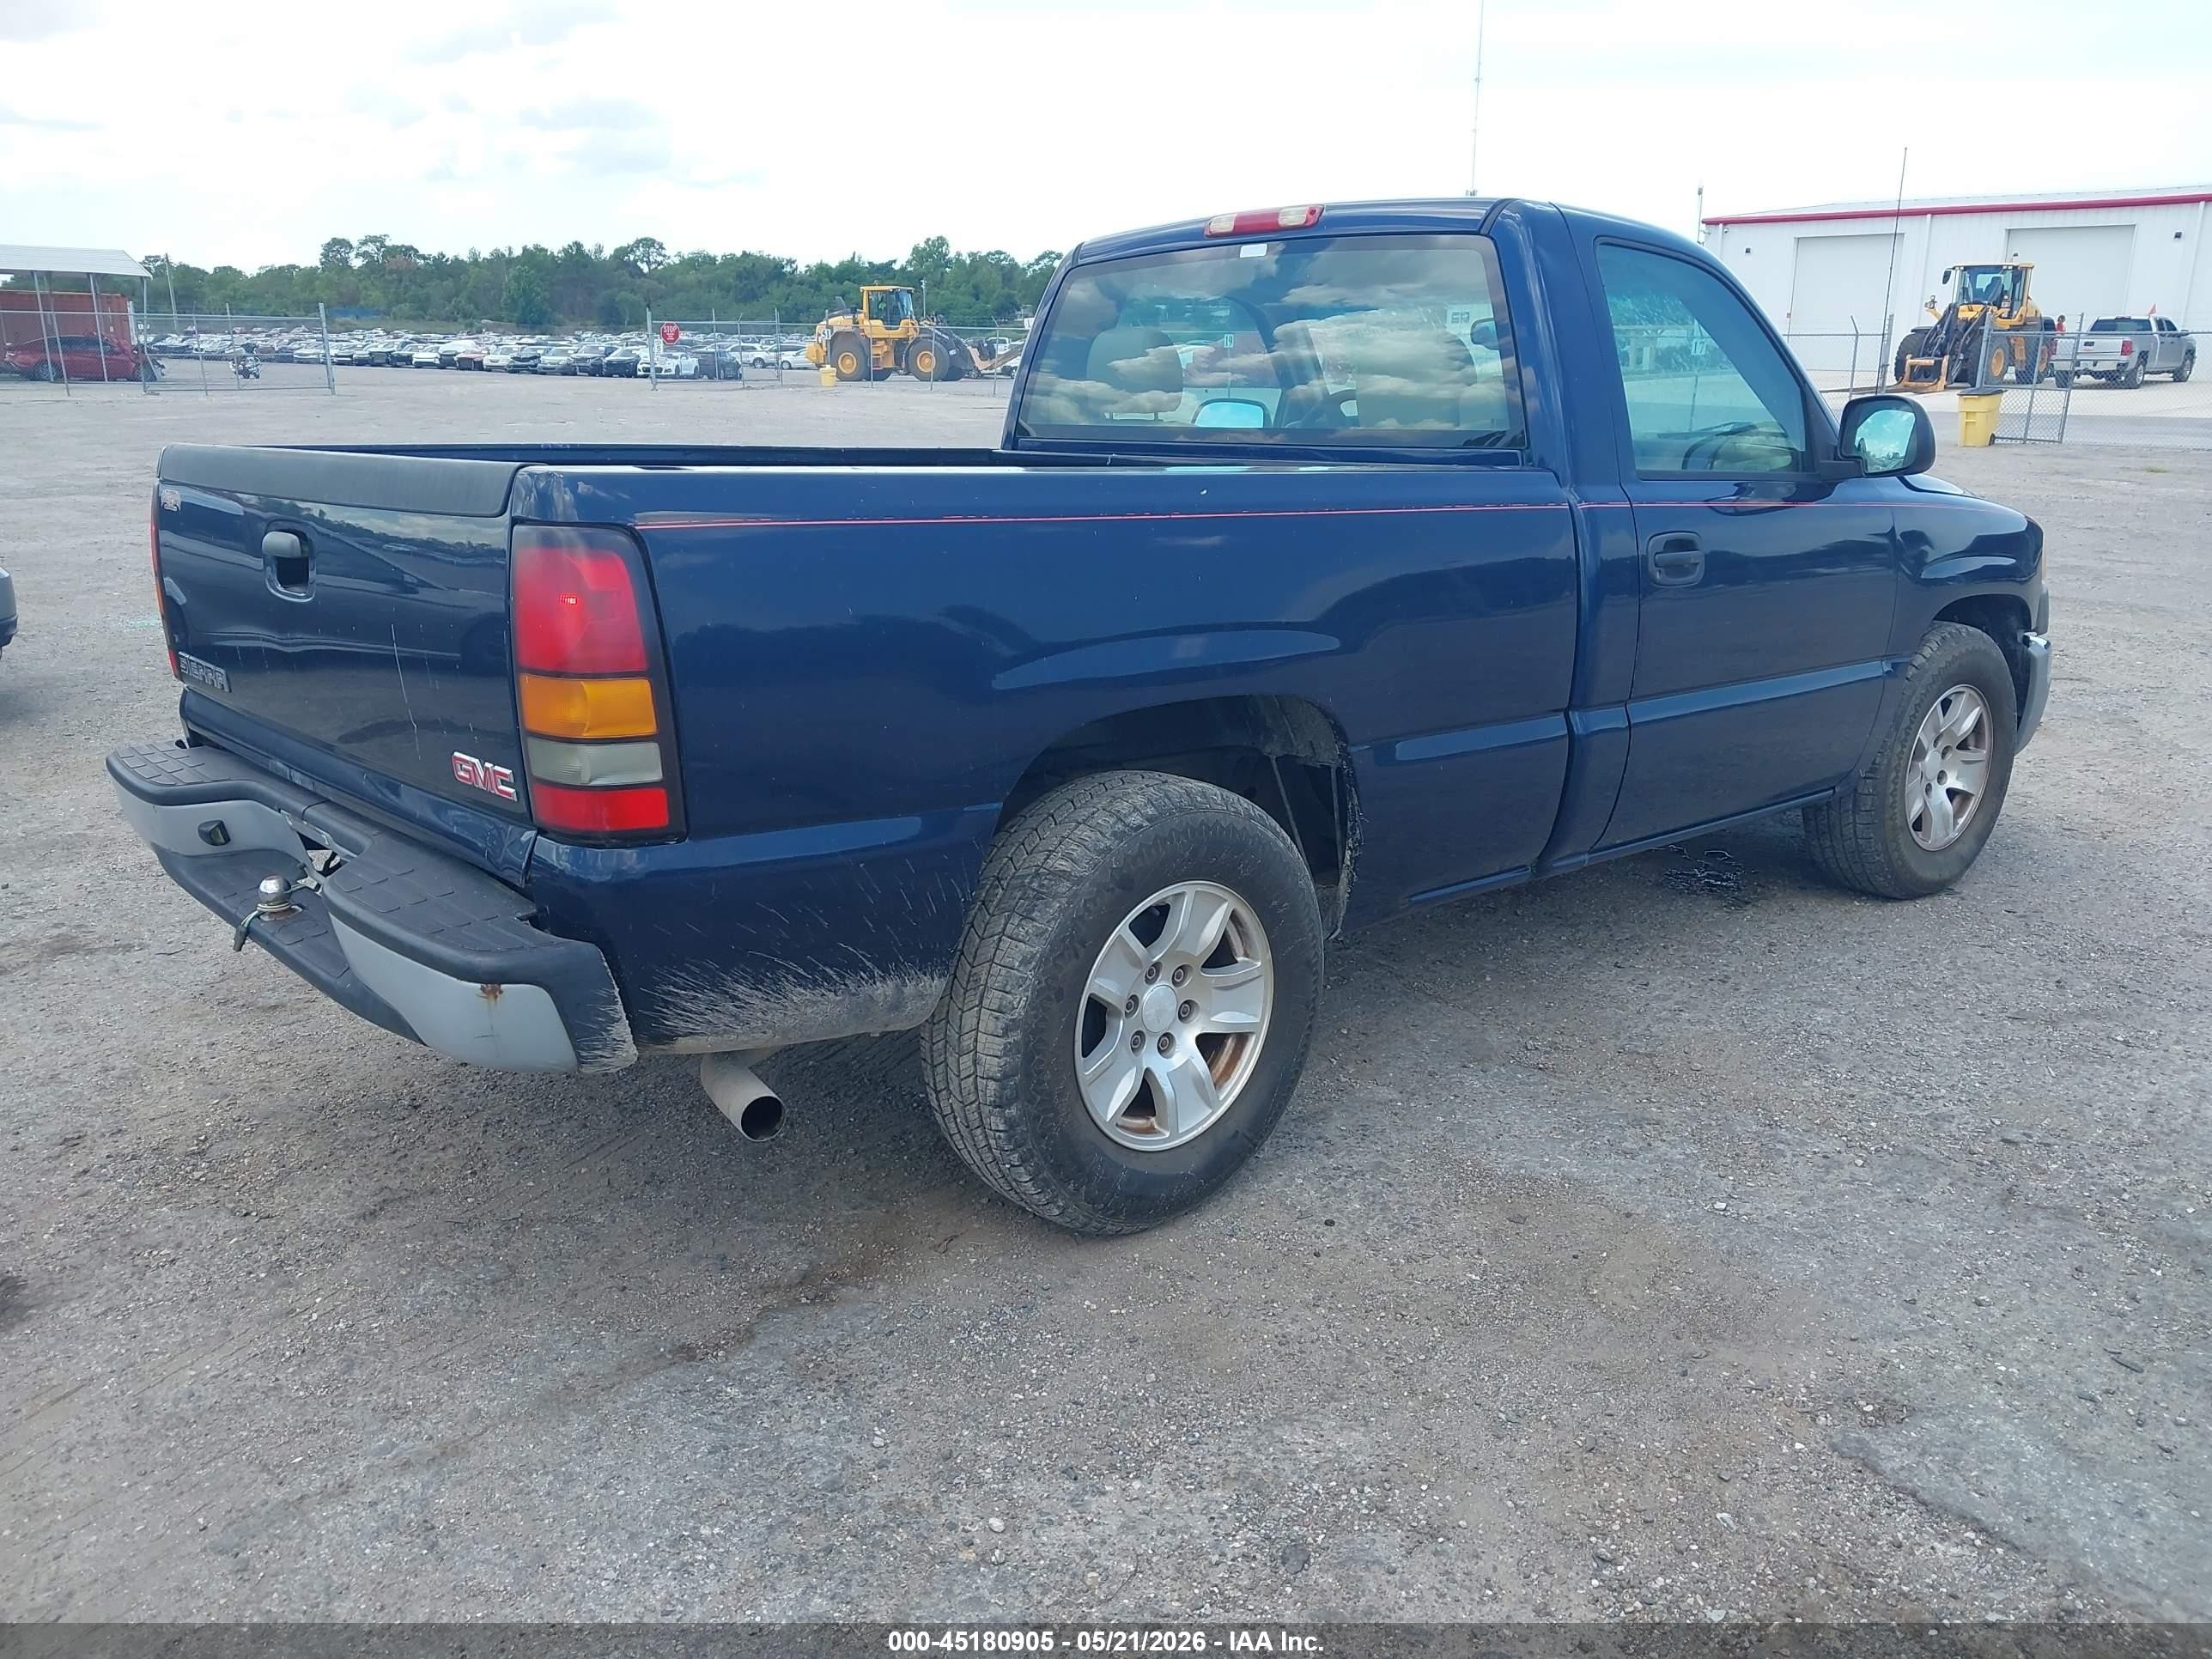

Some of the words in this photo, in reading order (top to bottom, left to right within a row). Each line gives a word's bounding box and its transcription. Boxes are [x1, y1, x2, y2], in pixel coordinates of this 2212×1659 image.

[1225, 336, 1233, 346] 19
[178, 651, 229, 693] SIERRA
[452, 751, 518, 802] GMC
